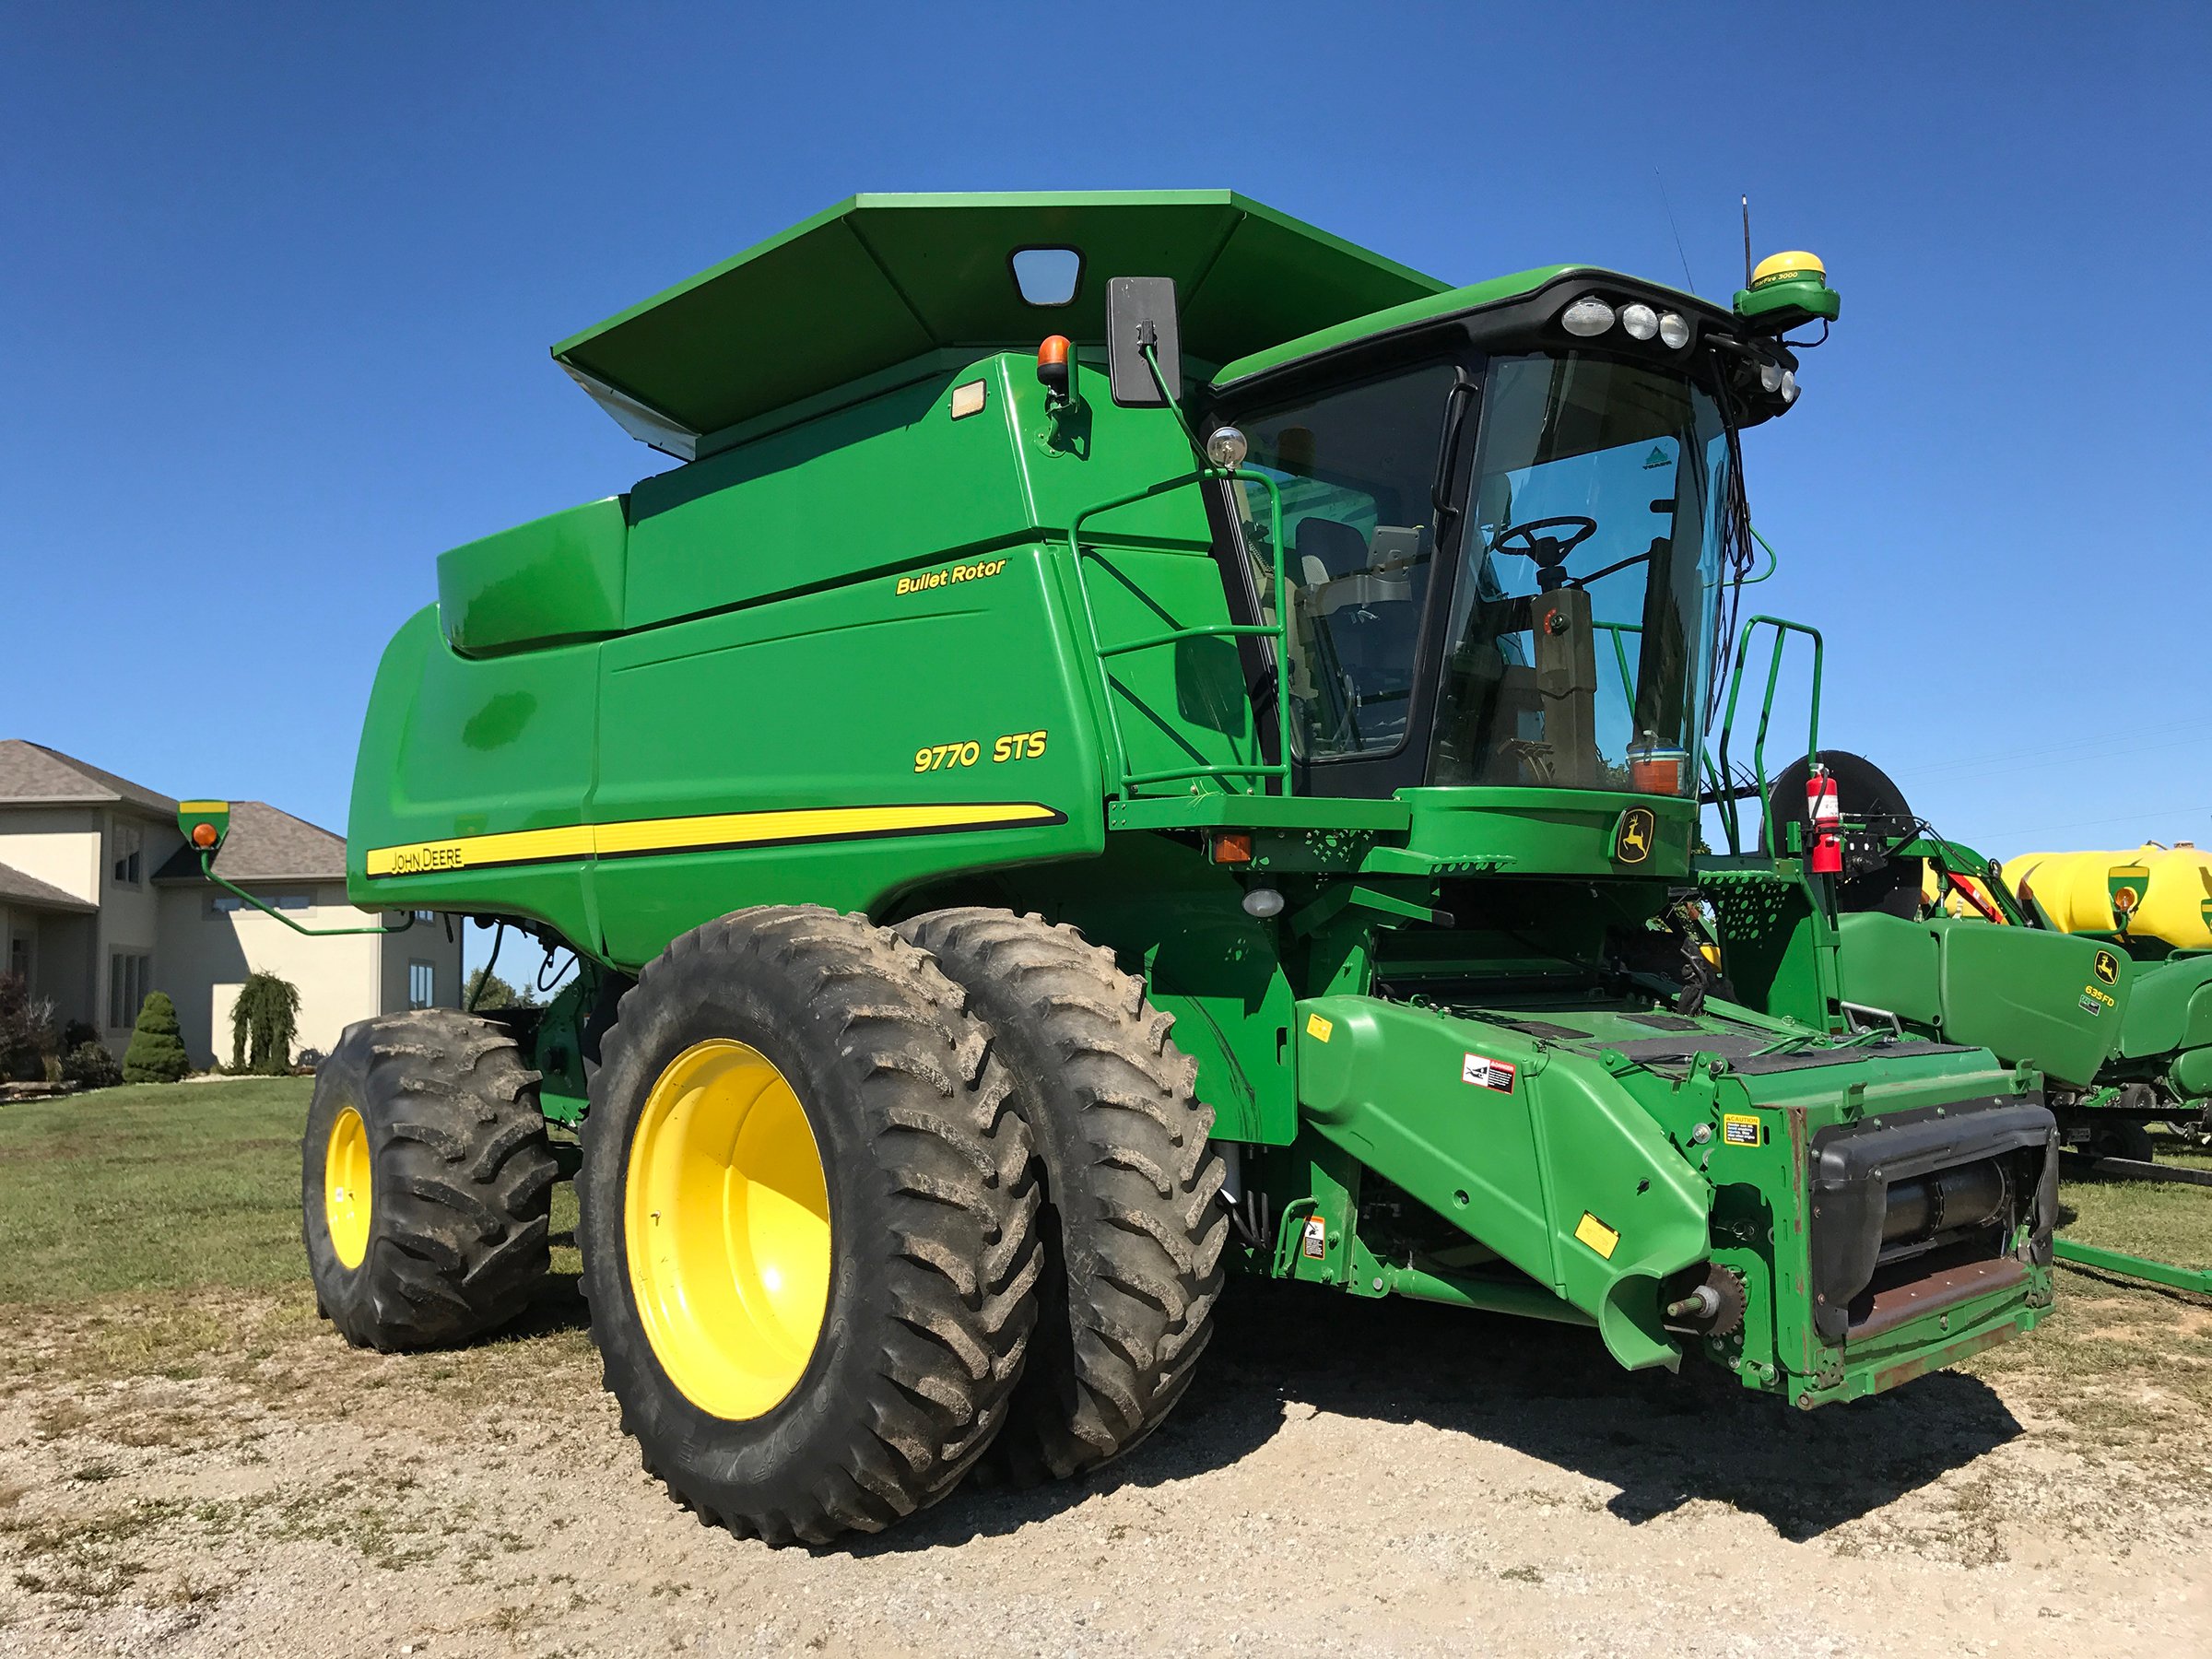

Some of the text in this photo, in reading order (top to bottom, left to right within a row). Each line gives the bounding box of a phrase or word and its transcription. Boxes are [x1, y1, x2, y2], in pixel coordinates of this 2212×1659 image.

[1778, 271, 1799, 280] 3000
[896, 559, 1006, 596] Bullet Rotor
[913, 730, 1048, 773] 9770 STS
[392, 848, 463, 871] JOHN DEERE
[2085, 985, 2114, 1007] 635FD
